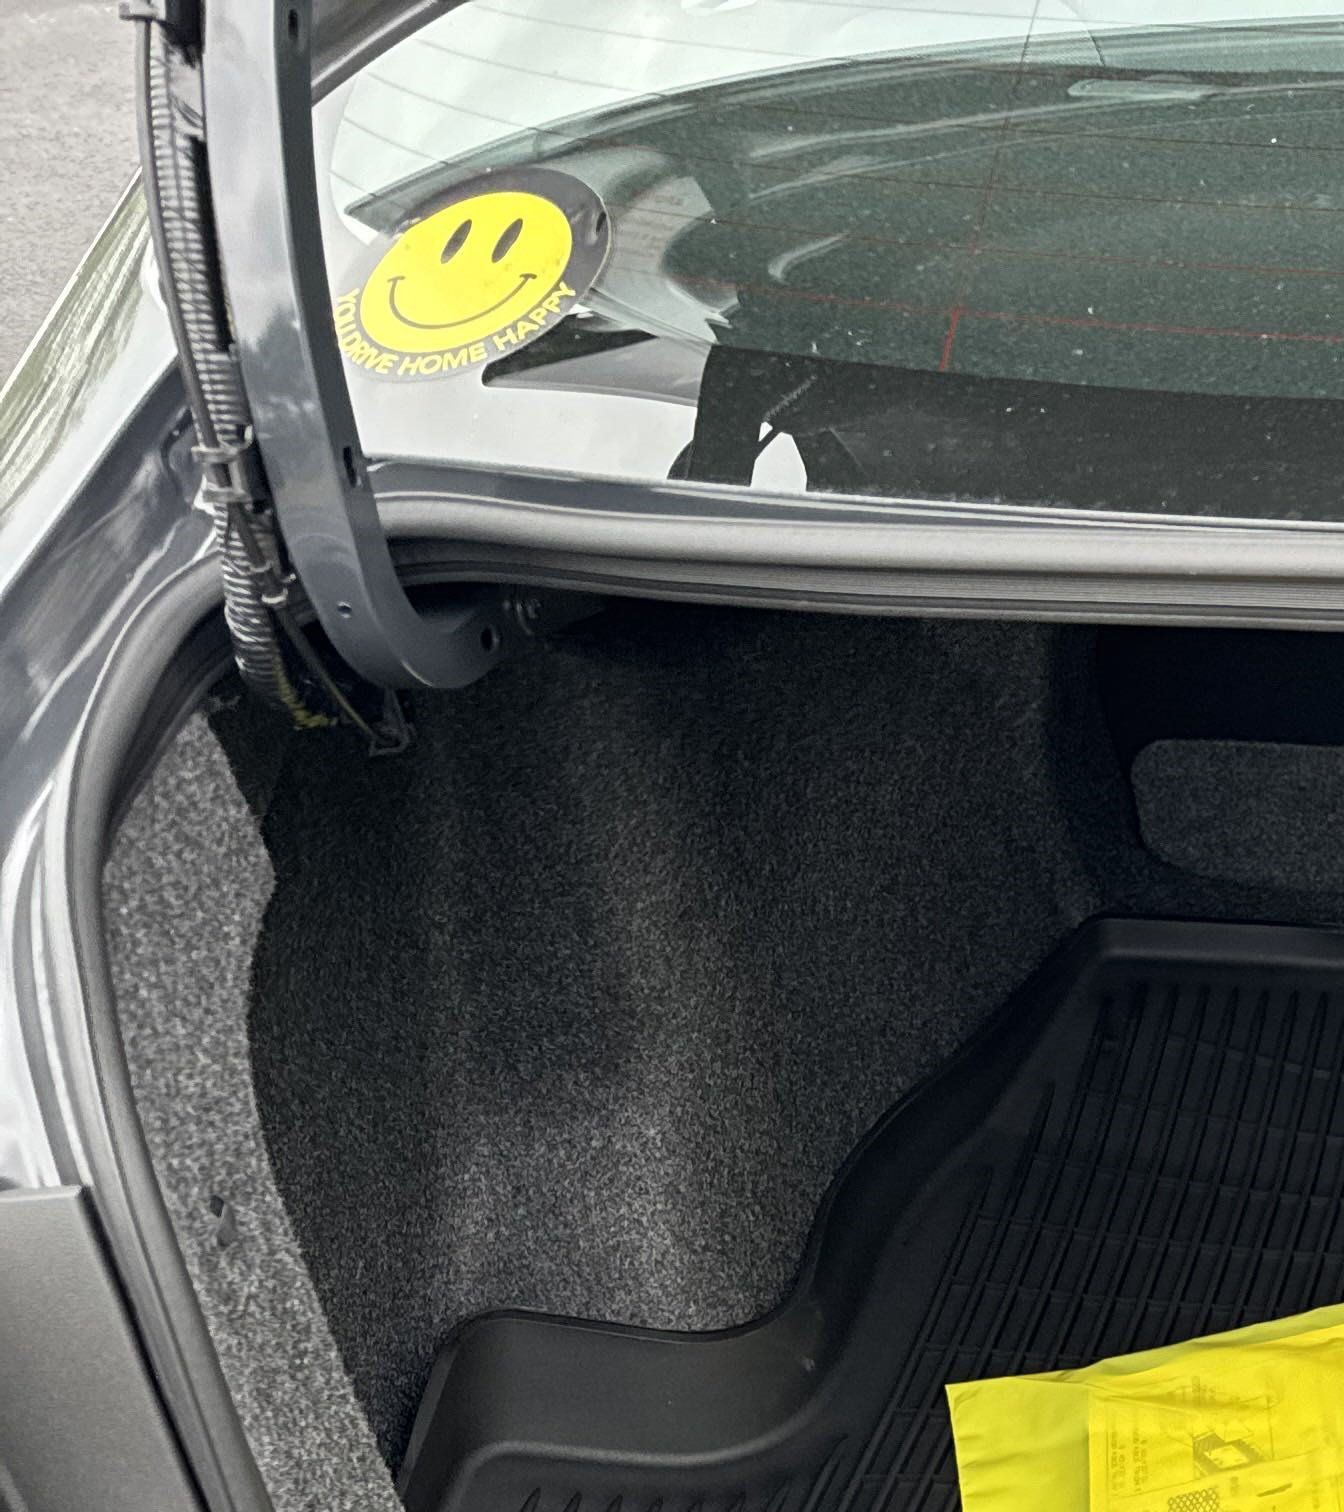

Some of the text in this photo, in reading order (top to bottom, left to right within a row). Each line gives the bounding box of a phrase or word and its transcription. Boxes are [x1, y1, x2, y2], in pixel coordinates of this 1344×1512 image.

[341, 330, 399, 375] DRIVE
[397, 342, 488, 378] HOME
[493, 281, 578, 351] HAPPY
